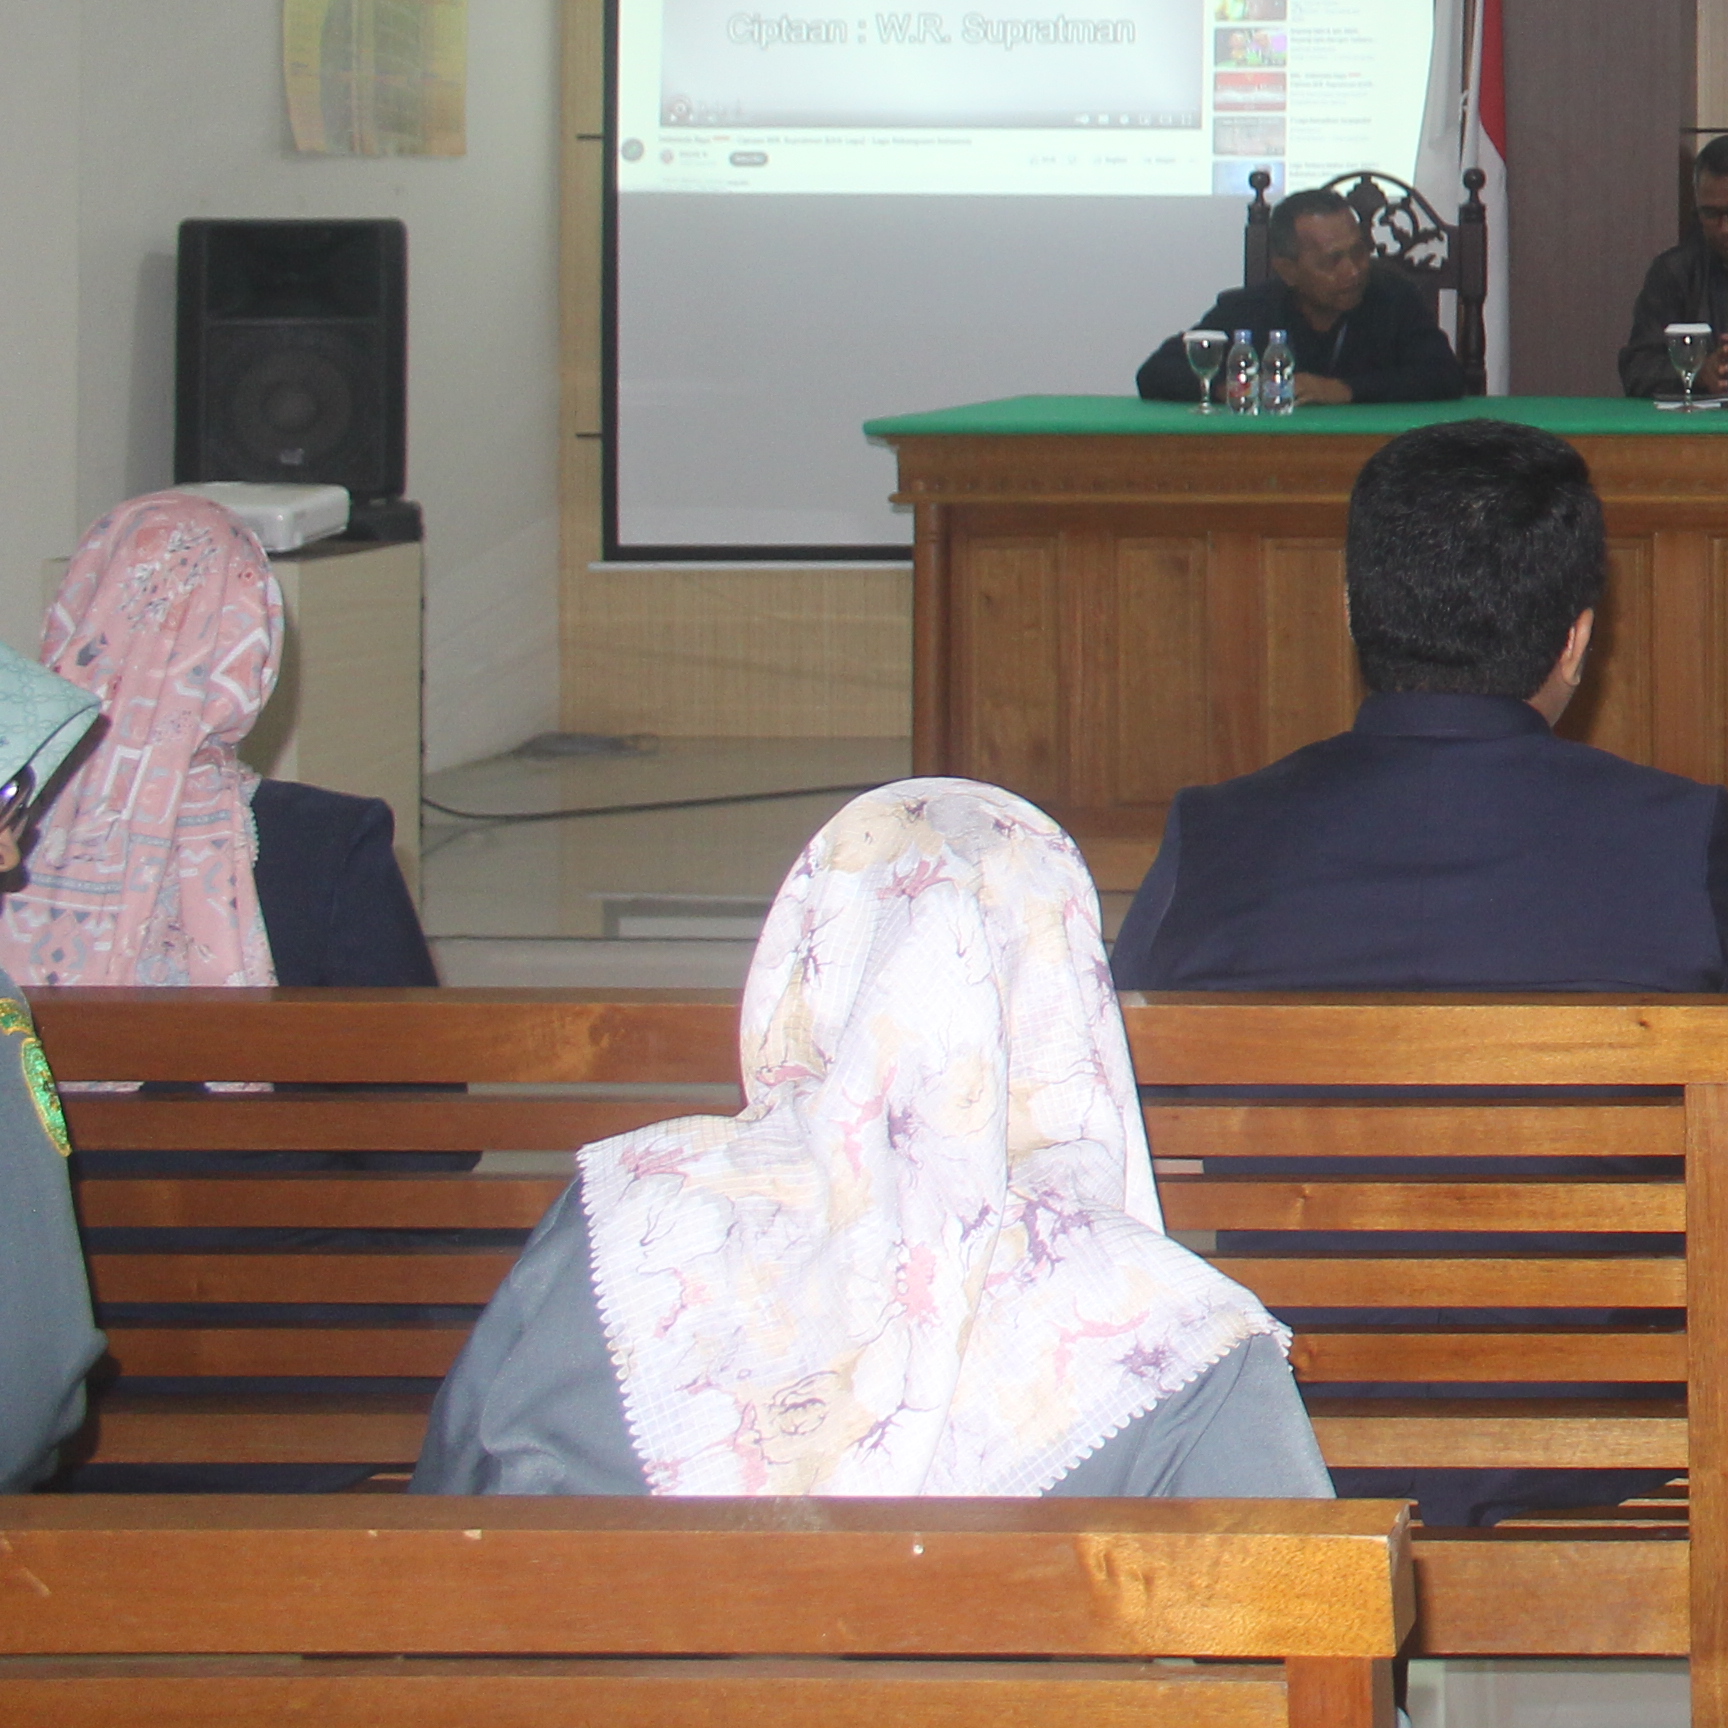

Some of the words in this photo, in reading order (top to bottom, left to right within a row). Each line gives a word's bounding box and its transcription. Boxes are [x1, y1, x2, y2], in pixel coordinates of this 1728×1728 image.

[727, 13, 848, 49] Ciptaan
[875, 13, 952, 45] W.R.
[961, 13, 1136, 50] Supratman
